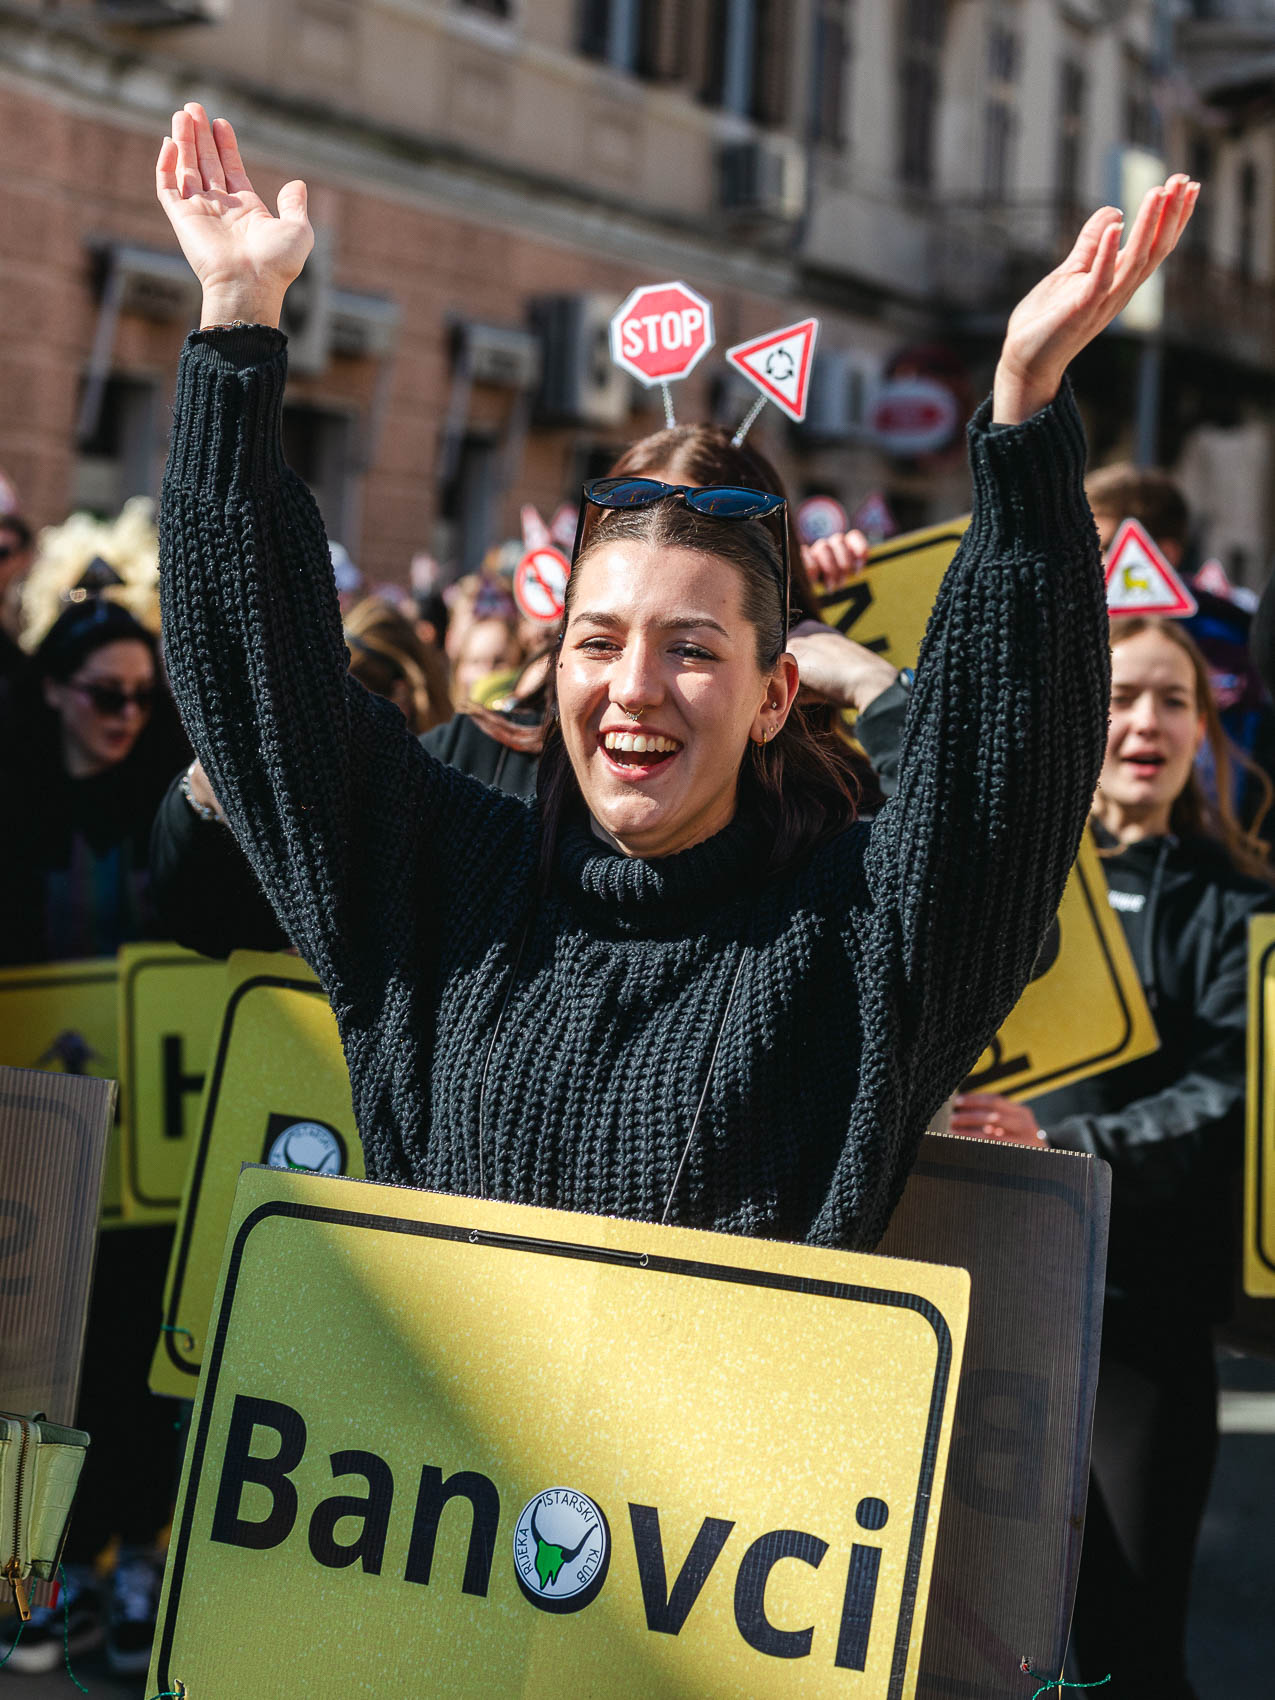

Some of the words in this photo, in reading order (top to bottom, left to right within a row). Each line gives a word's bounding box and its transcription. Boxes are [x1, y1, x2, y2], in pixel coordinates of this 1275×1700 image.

[622, 308, 703, 358] STOP
[541, 1491, 595, 1523] ISTARSKI
[517, 1528, 534, 1576] RIJEKA
[576, 1548, 600, 1584] KLUB
